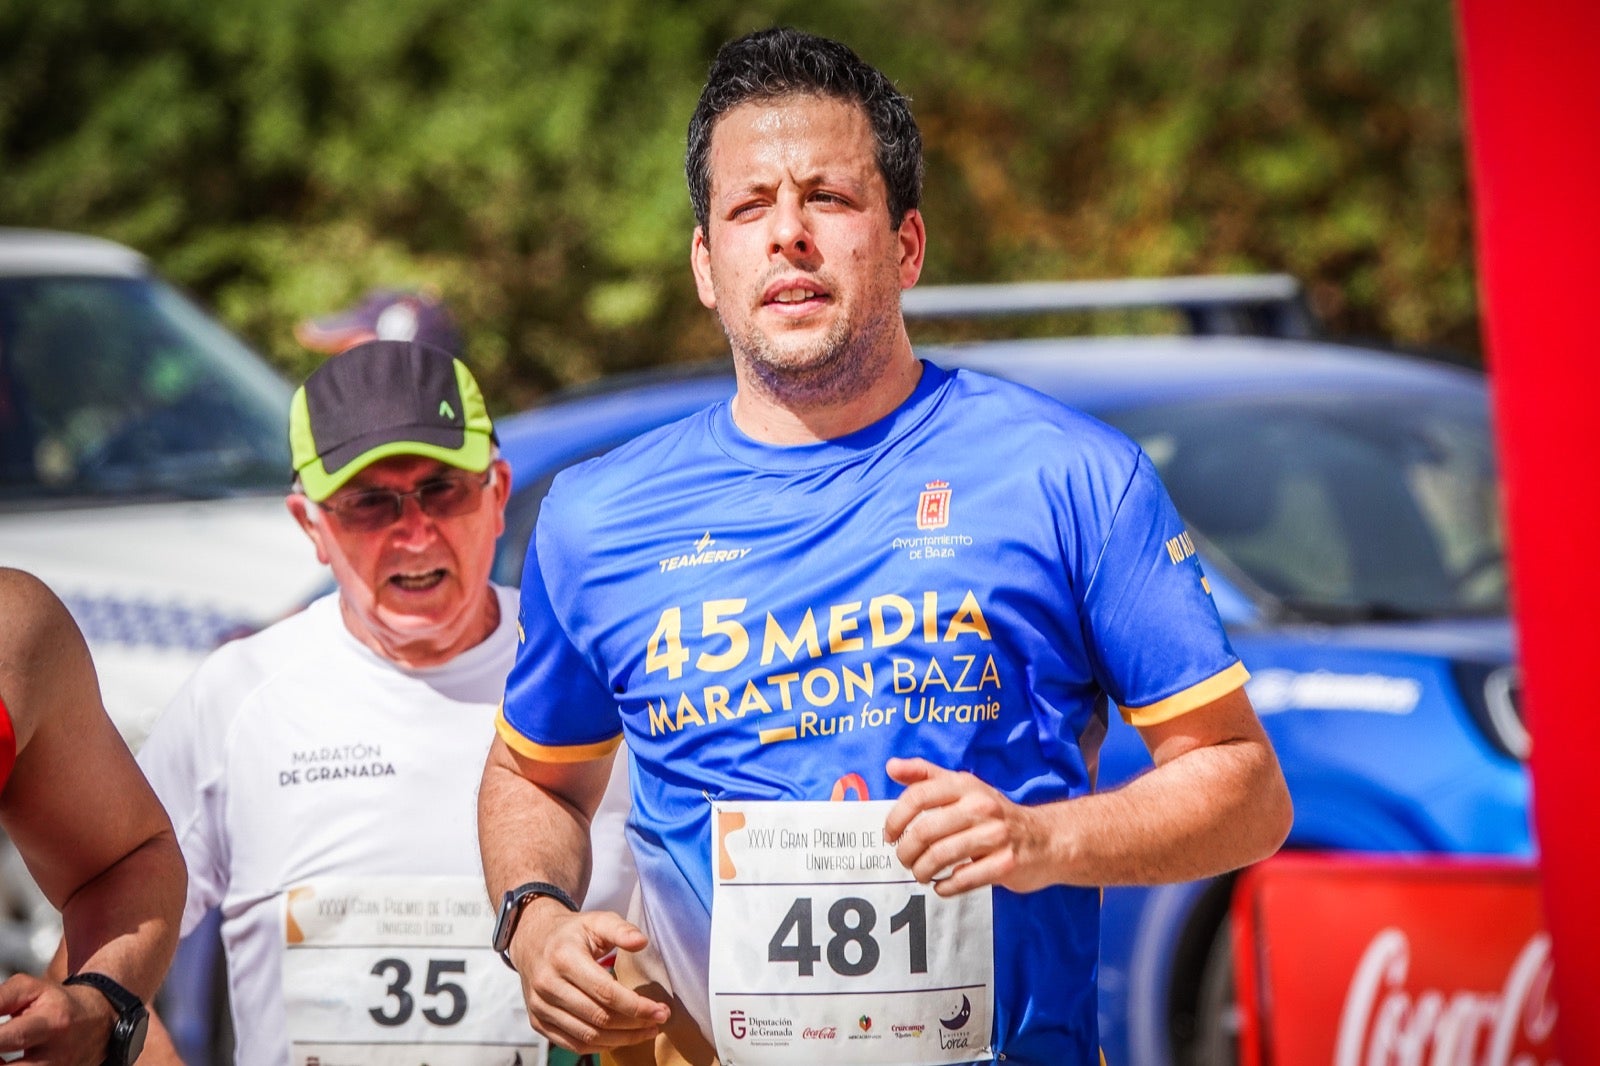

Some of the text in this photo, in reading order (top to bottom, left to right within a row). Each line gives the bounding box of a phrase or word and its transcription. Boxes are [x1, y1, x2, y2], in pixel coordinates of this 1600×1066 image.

[659, 547, 752, 573] TEAMERGY
[645, 589, 992, 680] 45 MEDIA
[648, 654, 1002, 737] MARATON BAZA
[800, 696, 1001, 738] Run for Ukranie
[279, 763, 396, 786] DE GRANADA
[768, 894, 928, 977] 481
[368, 958, 469, 1028] 35
[749, 1028, 793, 1037] de Granada
[939, 1029, 968, 1050] Lorca
